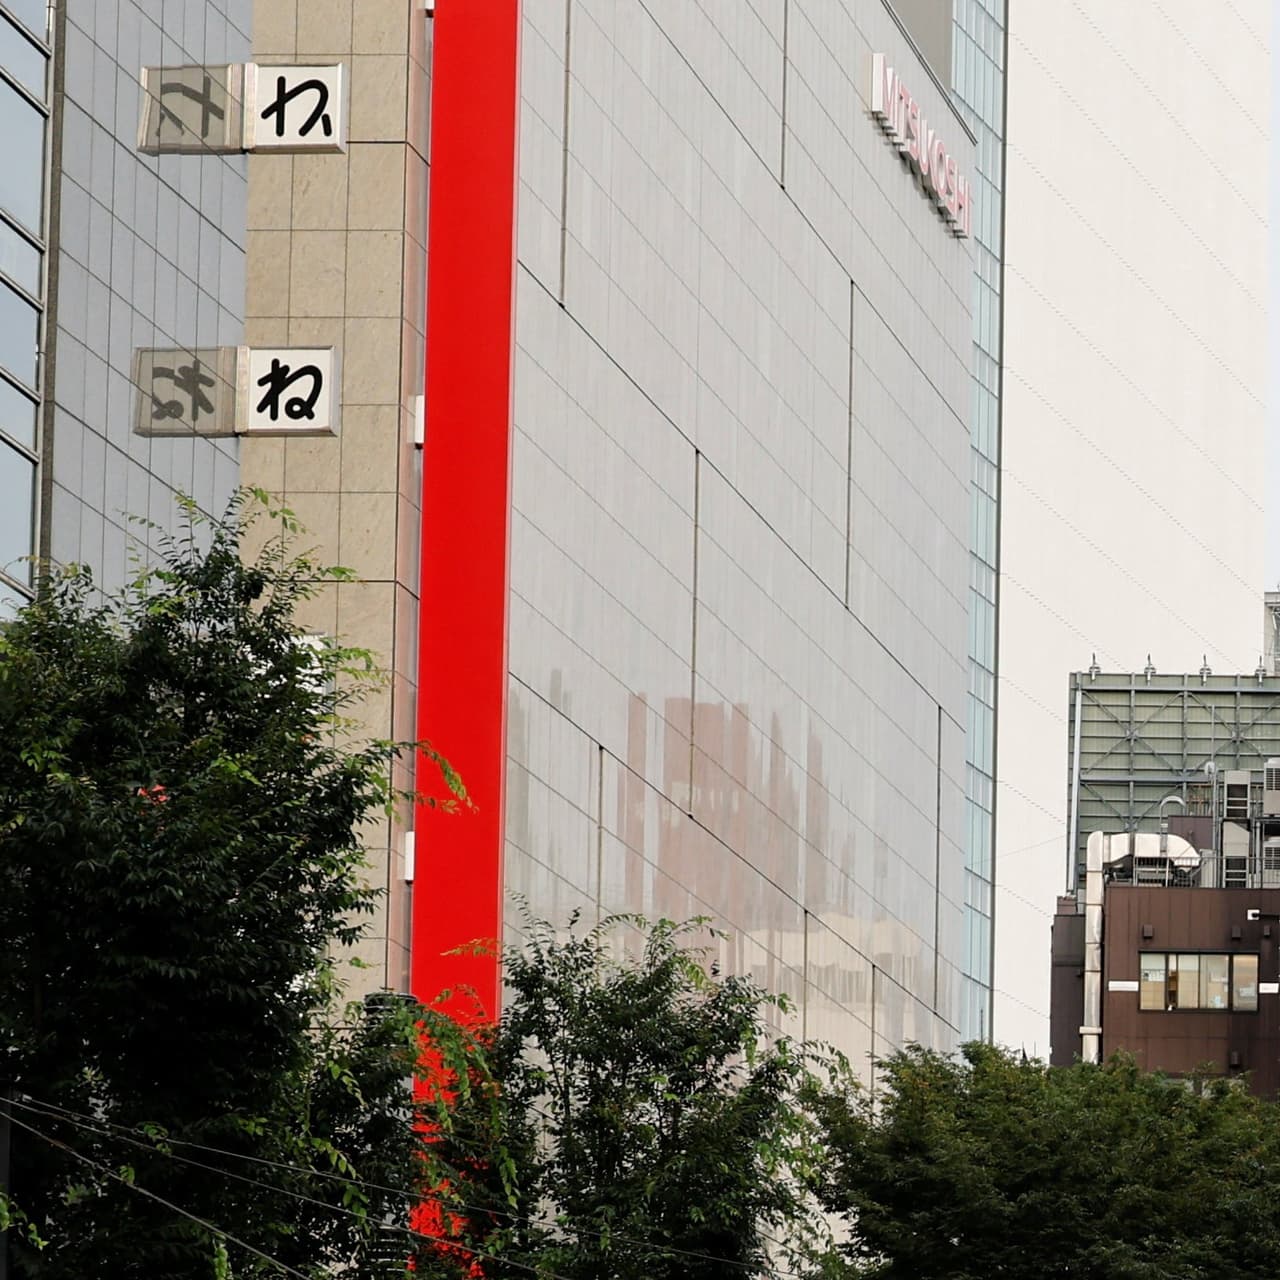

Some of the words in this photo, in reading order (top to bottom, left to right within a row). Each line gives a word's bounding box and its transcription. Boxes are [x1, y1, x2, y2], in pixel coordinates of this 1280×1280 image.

[261, 75, 332, 137] わ
[872, 53, 971, 238] MITSUKOSHI
[256, 358, 324, 421] ね
